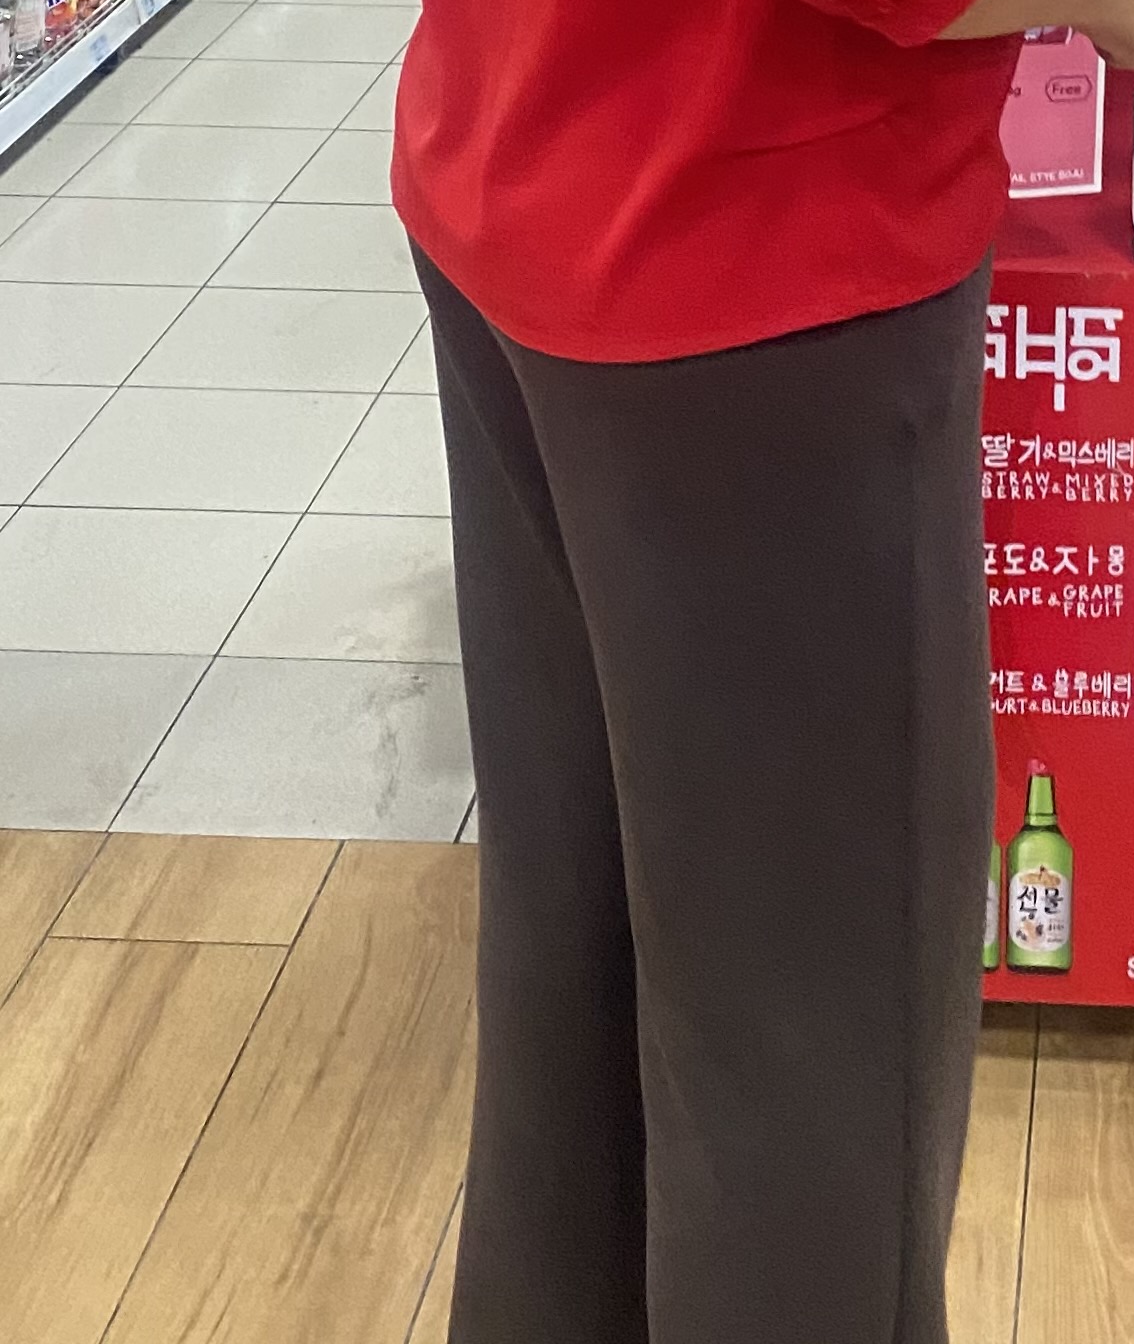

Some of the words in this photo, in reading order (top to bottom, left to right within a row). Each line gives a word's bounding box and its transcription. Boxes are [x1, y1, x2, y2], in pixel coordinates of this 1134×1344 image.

[1053, 83, 1081, 96] Free
[982, 470, 1050, 487] STRAW
[1066, 472, 1134, 489] MIXED
[981, 485, 1047, 501] BERRY
[1066, 487, 1133, 503] BERRY
[988, 587, 1042, 607] RAPE
[1063, 583, 1123, 602] GRAPE
[1063, 600, 1123, 618] FRUIT
[1042, 698, 1130, 718] BLUEBERRY
